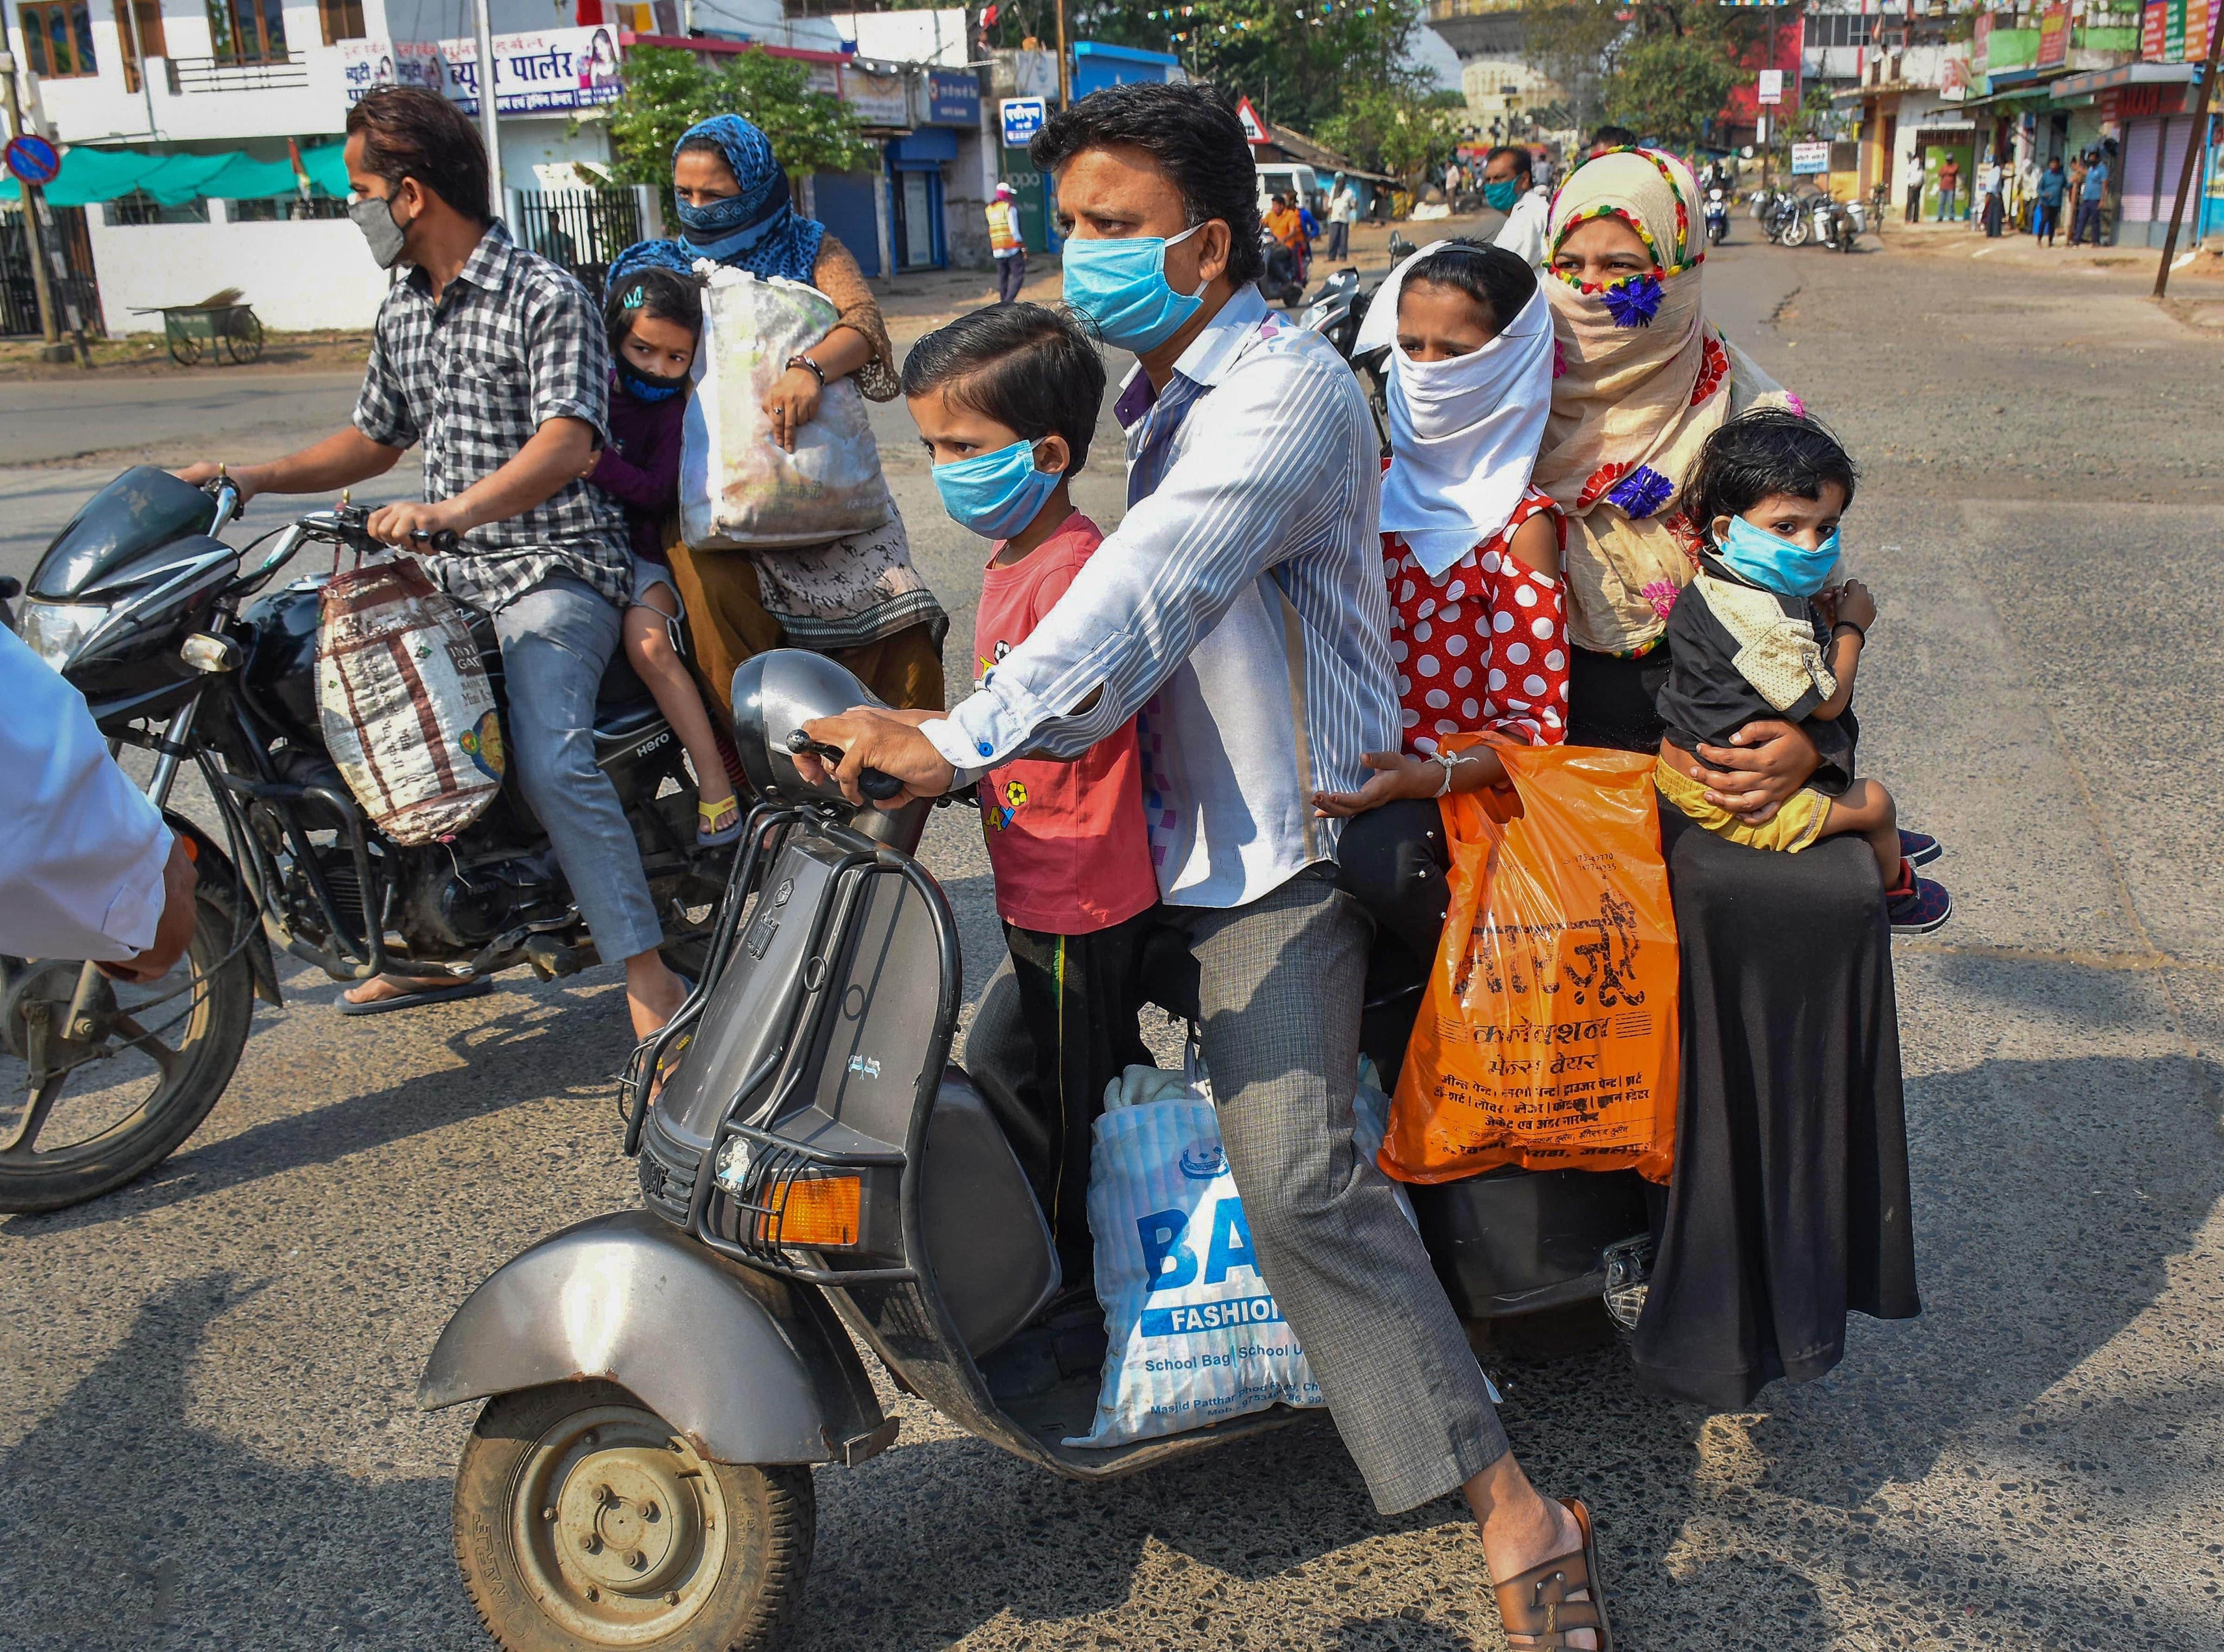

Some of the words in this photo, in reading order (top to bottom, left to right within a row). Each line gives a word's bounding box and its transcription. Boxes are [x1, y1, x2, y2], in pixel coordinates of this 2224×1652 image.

[509, 44, 573, 82] पार्लर
[636, 733, 669, 757] Hero
[1238, 1344, 1288, 1359] School
[1145, 1356, 1197, 1372] School
[1202, 1354, 1231, 1367] Bag
[1151, 1401, 1190, 1414] Masjid
[1194, 1395, 1236, 1409] Patthar
